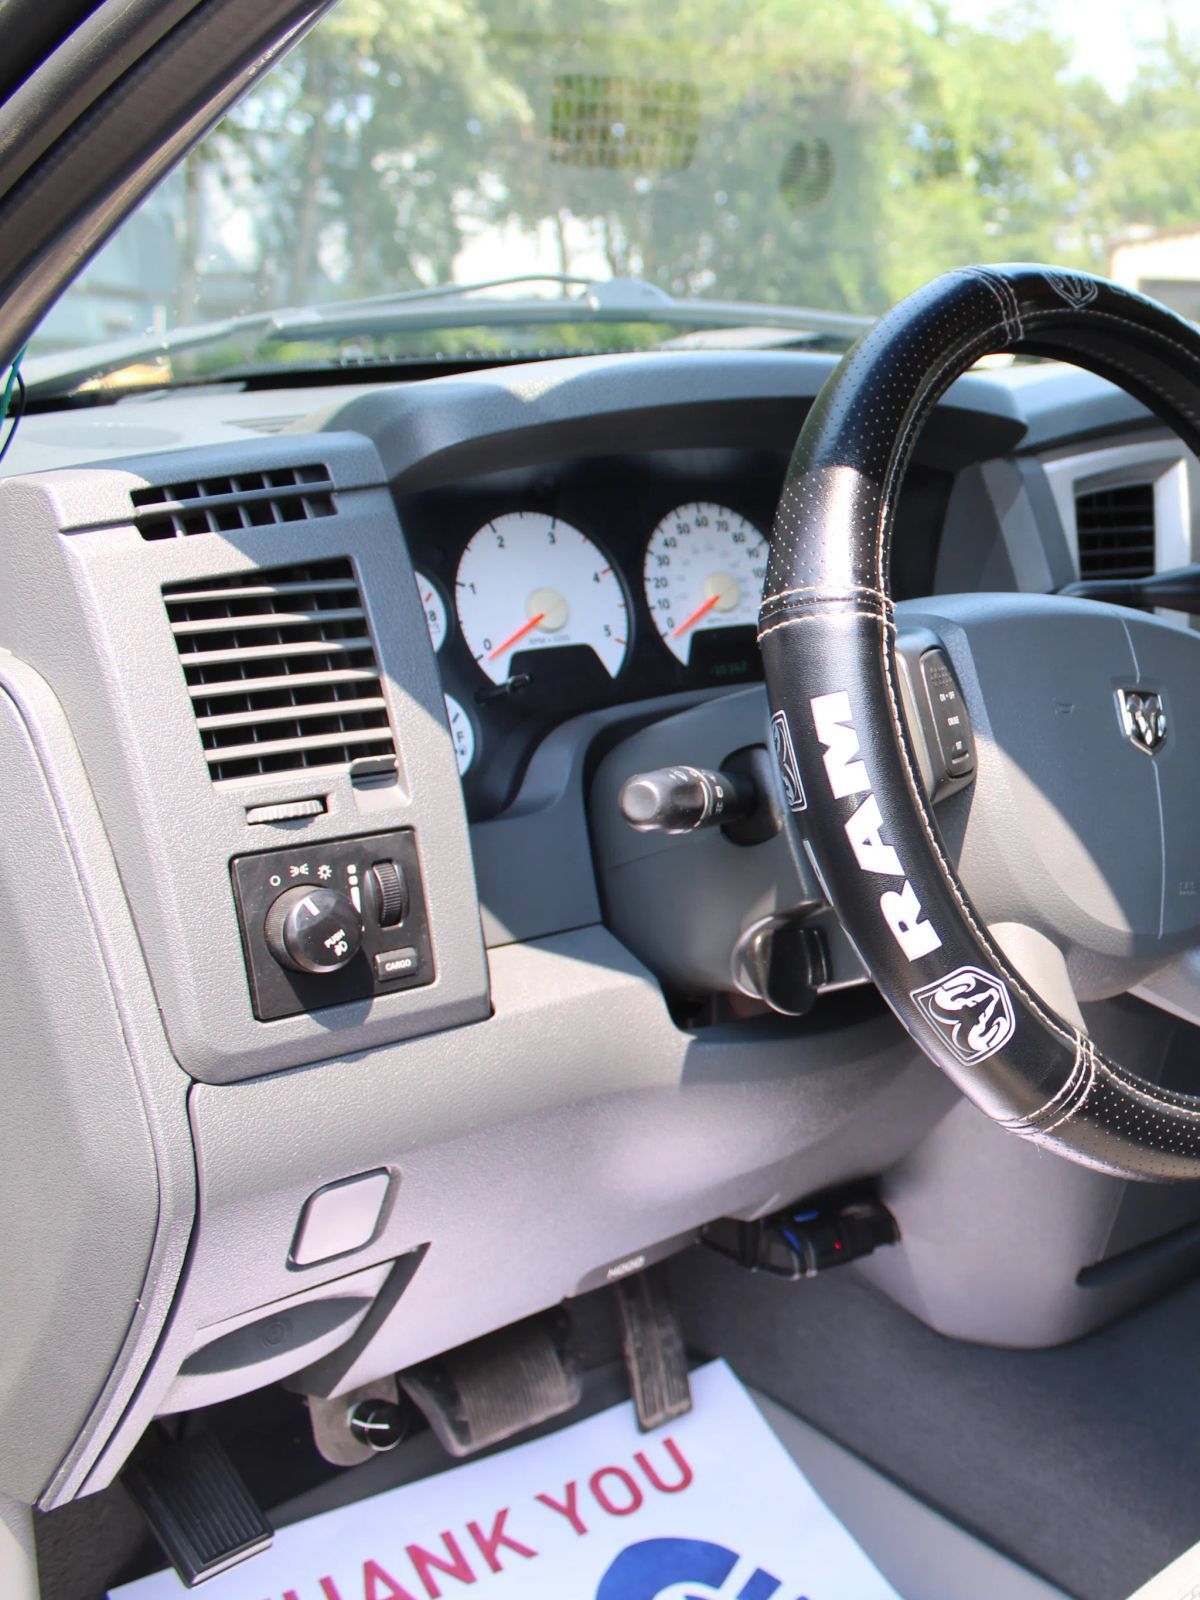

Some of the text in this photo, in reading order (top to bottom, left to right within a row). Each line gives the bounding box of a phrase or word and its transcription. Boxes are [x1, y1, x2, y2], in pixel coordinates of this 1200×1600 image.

[695, 515, 709, 527] 60
[715, 519, 729, 532] 70
[676, 523, 691, 535] 50
[496, 535, 505, 548] 2
[547, 532, 556, 545] 3
[663, 536, 677, 549] 40
[732, 531, 746, 544] 80
[746, 547, 759, 559] 90
[656, 554, 670, 567] 30
[592, 572, 600, 584] 4
[654, 576, 669, 589] 20
[469, 582, 476, 595] 1
[657, 598, 670, 610] 10
[603, 624, 612, 638] 5
[483, 638, 492, 651] 0
[809, 691, 942, 961] RAM
[324, 929, 346, 948] PUSH
[385, 959, 412, 971] CARGO
[262, 1437, 694, 1600] ANK YOU
